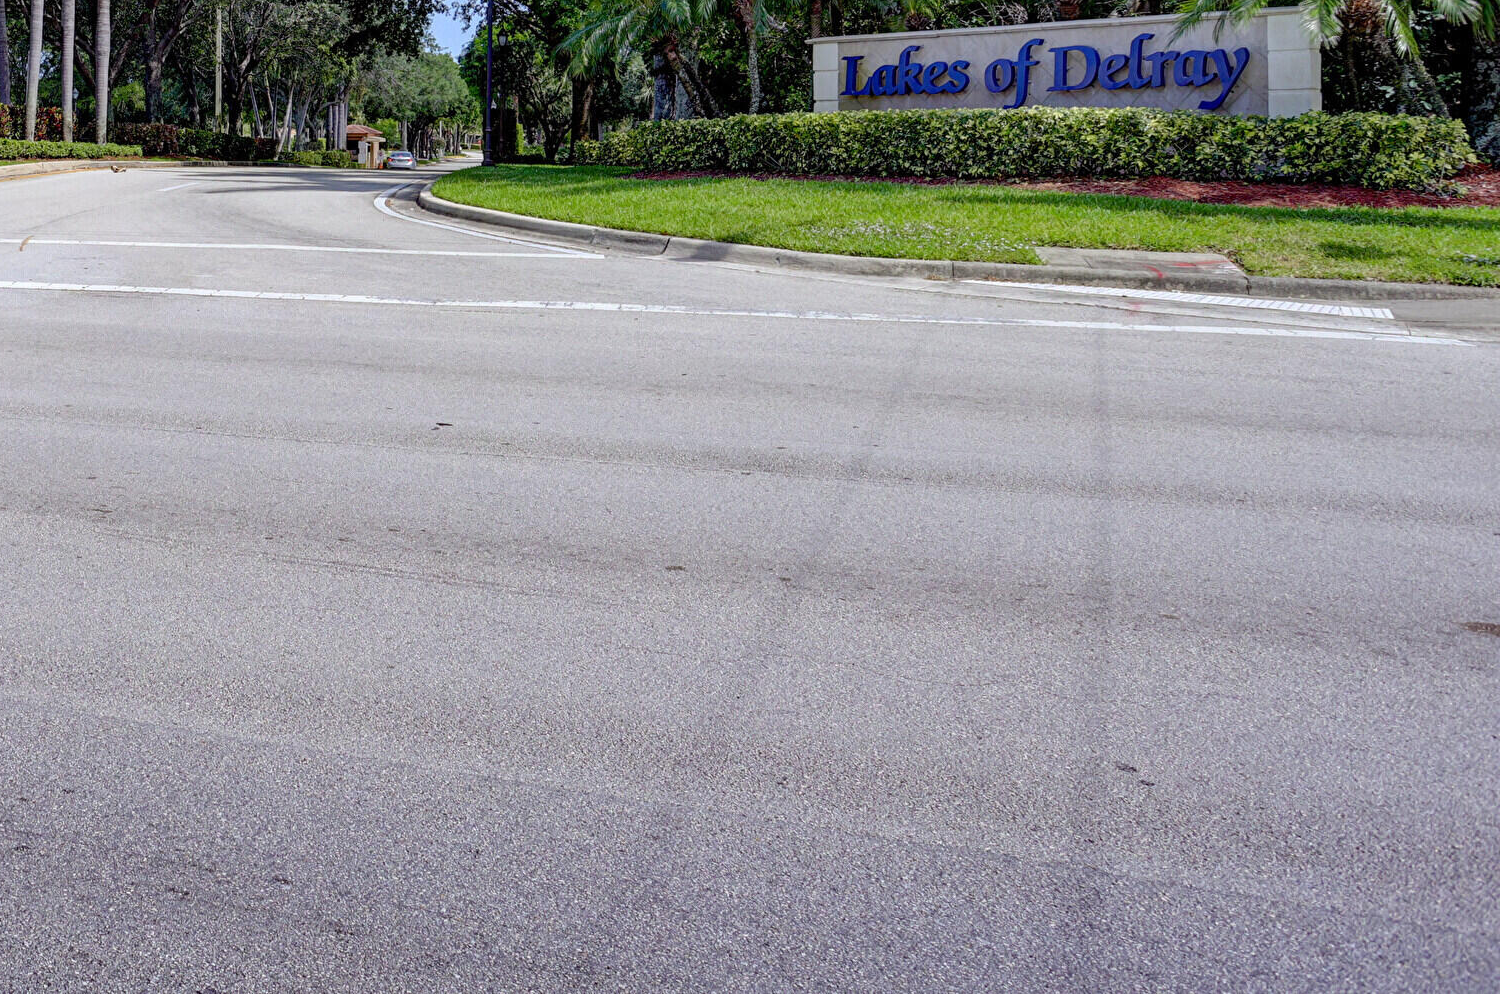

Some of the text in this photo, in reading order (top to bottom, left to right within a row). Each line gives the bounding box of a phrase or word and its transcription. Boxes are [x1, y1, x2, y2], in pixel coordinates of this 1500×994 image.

[840, 33, 1250, 110] Lakes of Delray
